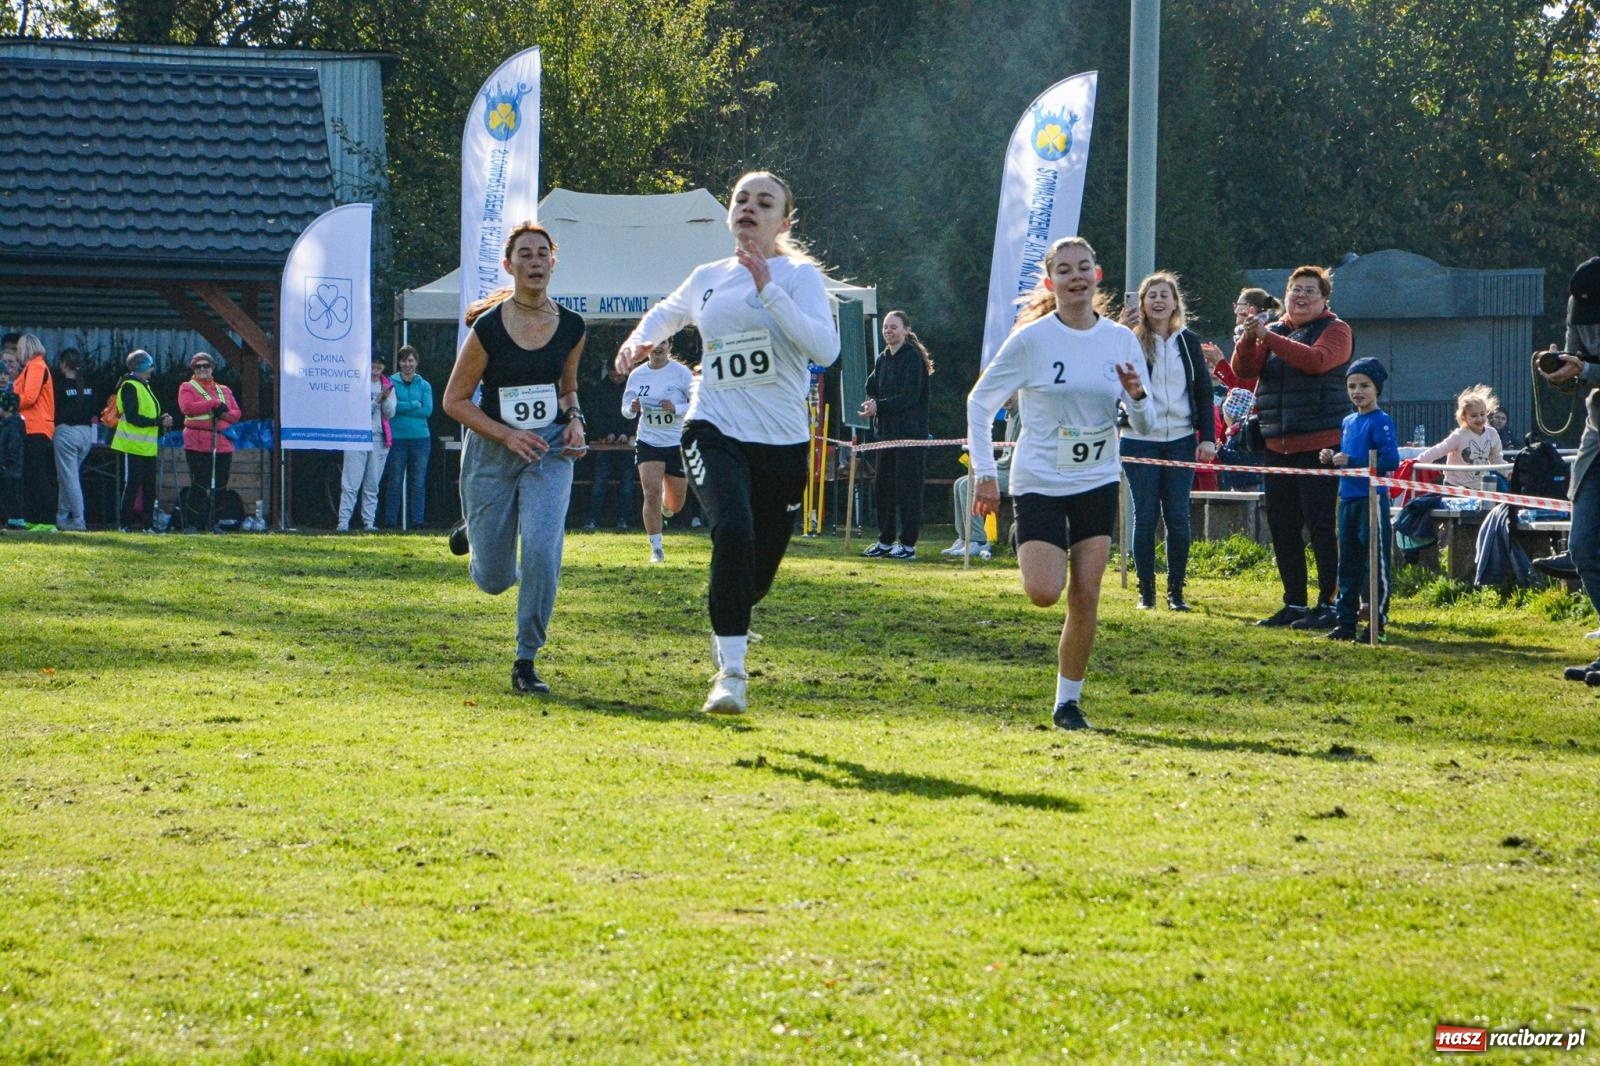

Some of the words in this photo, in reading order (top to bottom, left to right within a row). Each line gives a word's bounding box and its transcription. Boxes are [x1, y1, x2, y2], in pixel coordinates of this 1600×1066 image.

[1027, 167, 1058, 240] STOWARZYSZENIE
[600, 296, 648, 313] AKTYWNI
[312, 352, 345, 363] GMINA
[711, 350, 770, 380] 109
[298, 367, 361, 378] PIETROWICE
[1053, 361, 1066, 384] 2
[309, 382, 350, 393] WIELKIE
[638, 385, 650, 397] 22
[514, 400, 546, 421] 98
[646, 413, 673, 425] 110
[1072, 440, 1107, 463] 97
